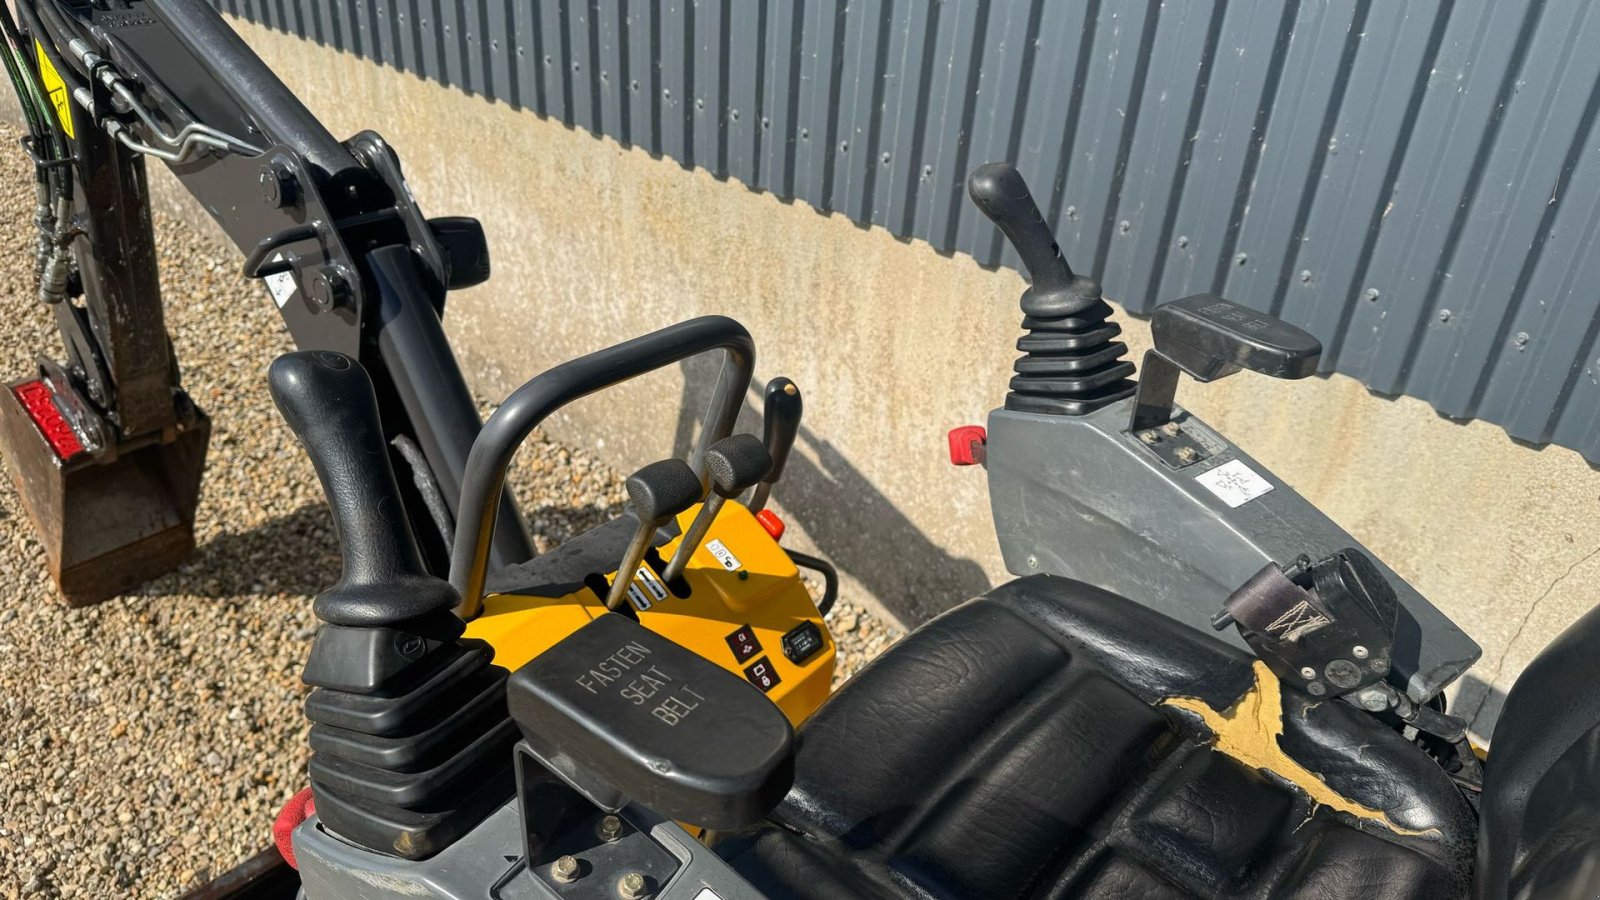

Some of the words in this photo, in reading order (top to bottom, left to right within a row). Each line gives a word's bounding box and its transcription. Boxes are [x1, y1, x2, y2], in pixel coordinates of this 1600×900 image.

[575, 640, 653, 694] FASTEN
[620, 665, 672, 705] SEAT
[651, 684, 705, 726] BELT
